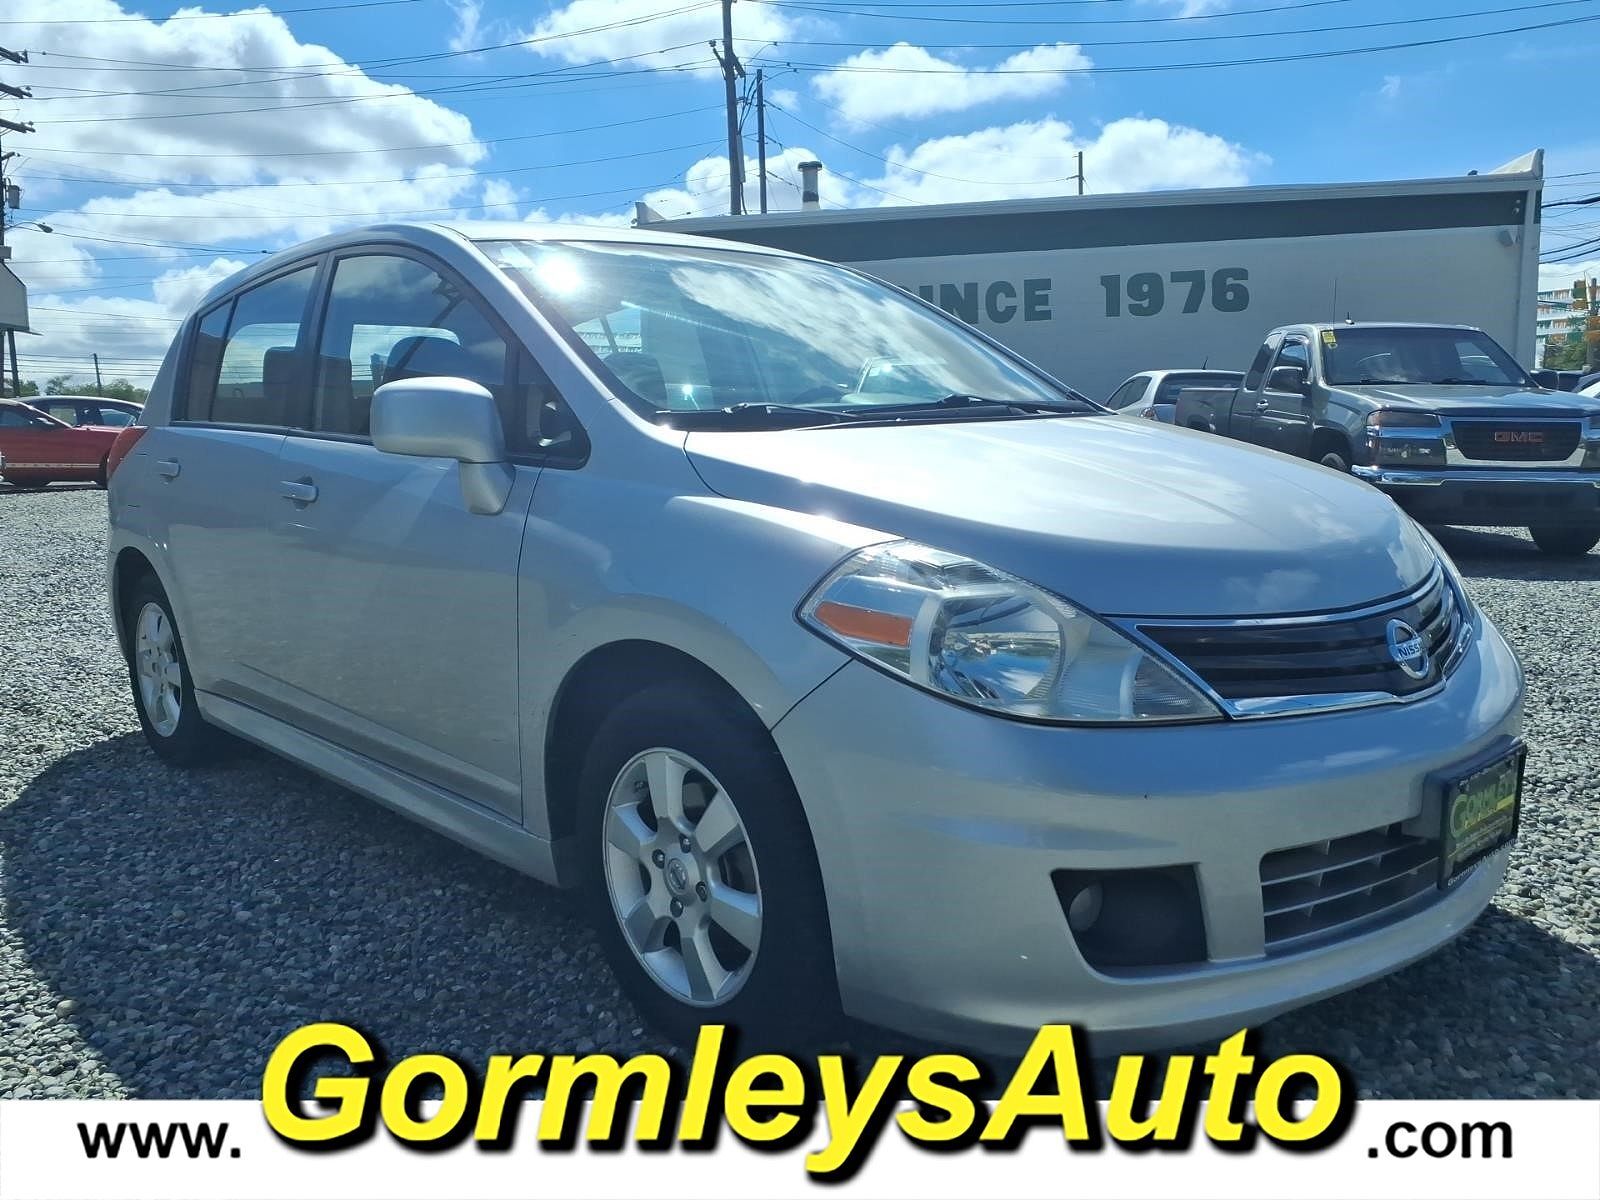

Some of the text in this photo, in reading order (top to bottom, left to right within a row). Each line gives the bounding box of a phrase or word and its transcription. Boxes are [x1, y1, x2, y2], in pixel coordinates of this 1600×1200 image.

[898, 268, 1249, 325] NCE 1976
[1494, 431, 1544, 442] GMC
[1398, 643, 1420, 657] NISS
